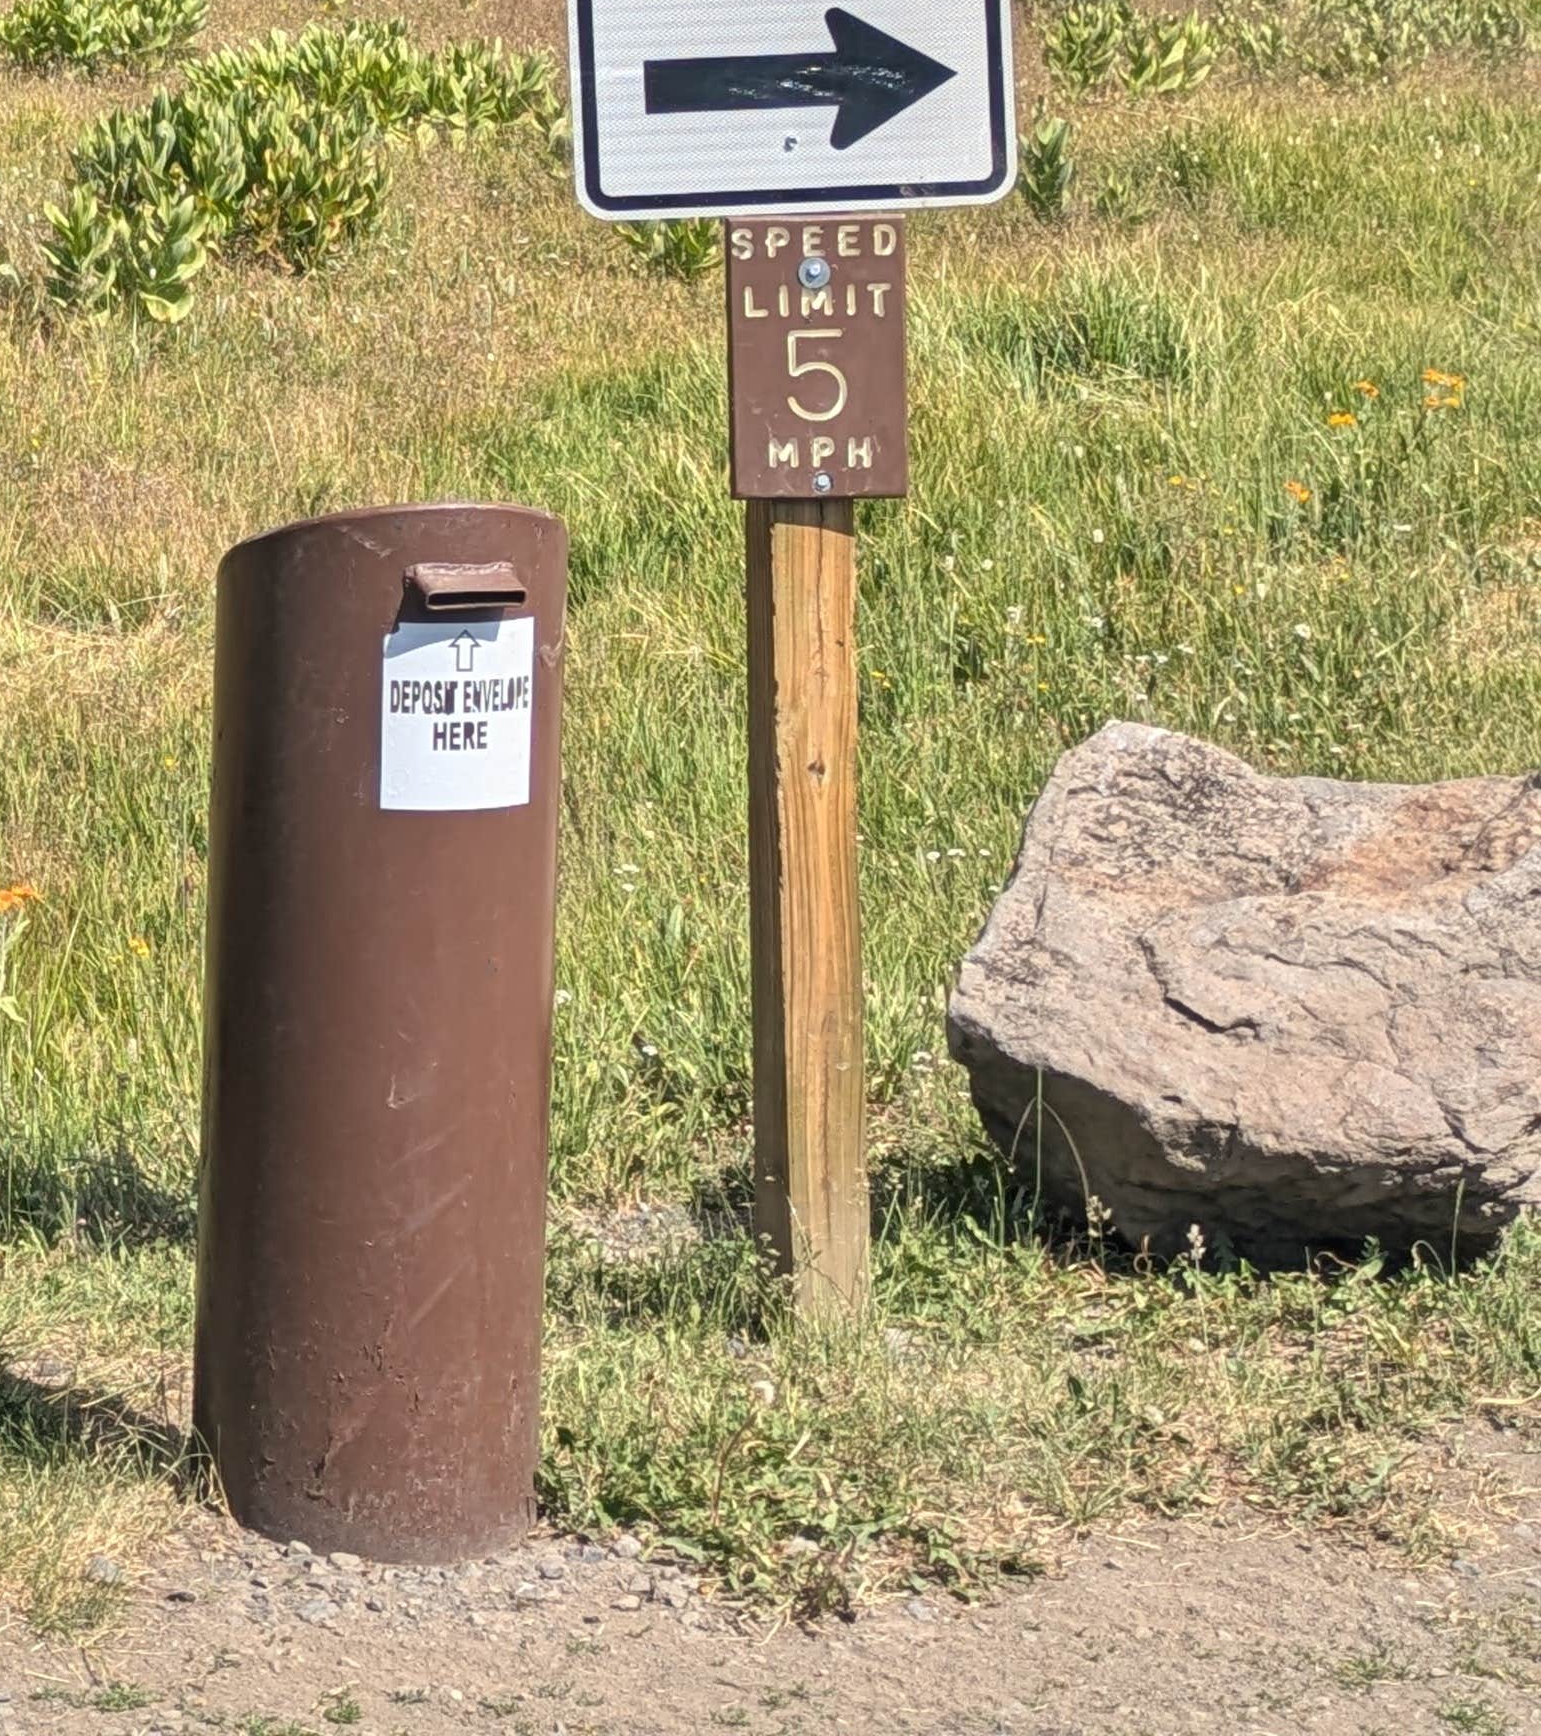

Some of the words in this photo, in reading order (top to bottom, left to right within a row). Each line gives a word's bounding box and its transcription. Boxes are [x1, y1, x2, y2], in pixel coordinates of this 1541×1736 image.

[731, 223, 897, 260] SPEED
[744, 283, 892, 318] LIMIT
[787, 328, 848, 422] 5
[768, 436, 873, 468] MPH
[390, 679, 458, 715] DEPOSIT
[463, 675, 529, 714] ENVELOPE
[433, 721, 488, 751] HERE
